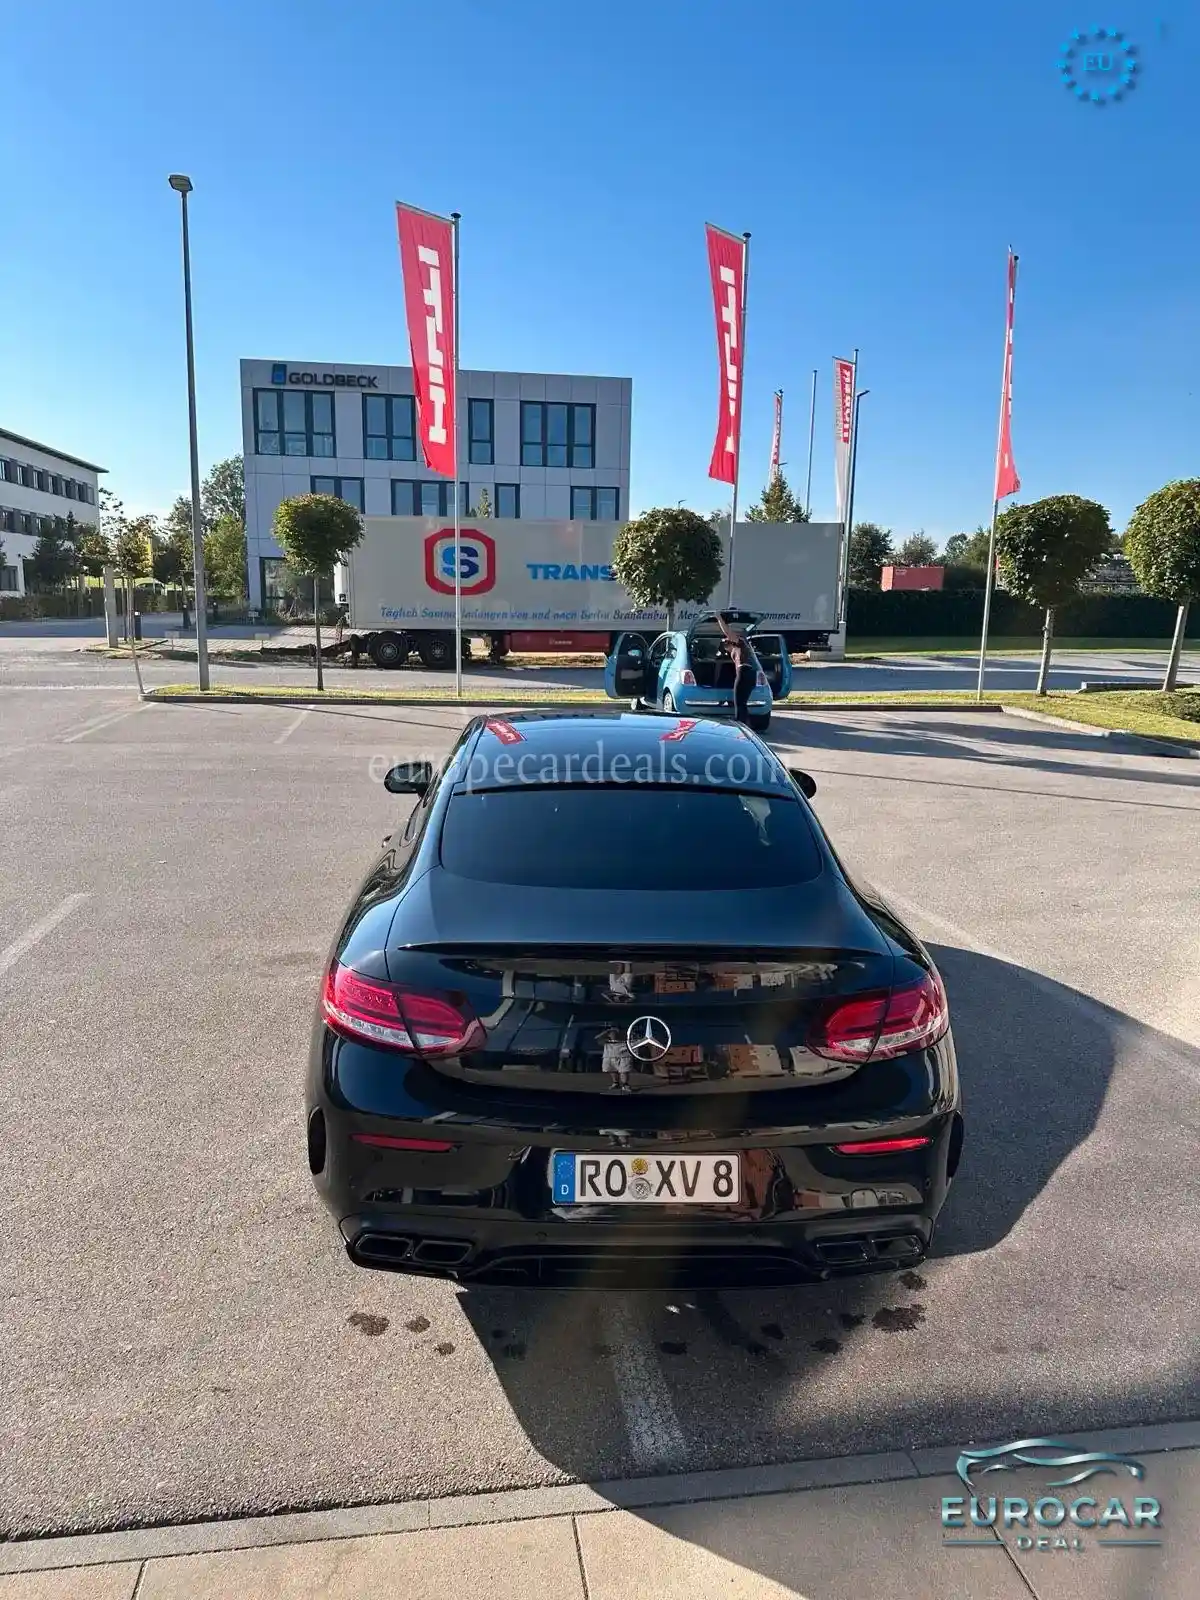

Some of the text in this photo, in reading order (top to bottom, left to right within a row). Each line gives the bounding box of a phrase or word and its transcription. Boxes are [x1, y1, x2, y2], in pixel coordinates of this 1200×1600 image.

[288, 372, 379, 388] GOLDBECK
[381, 606, 417, 620] Täglich
[421, 606, 508, 619] Sammeladungen
[532, 608, 550, 619] und
[580, 1159, 734, 1198] RO XV 8
[561, 1184, 569, 1195] D
